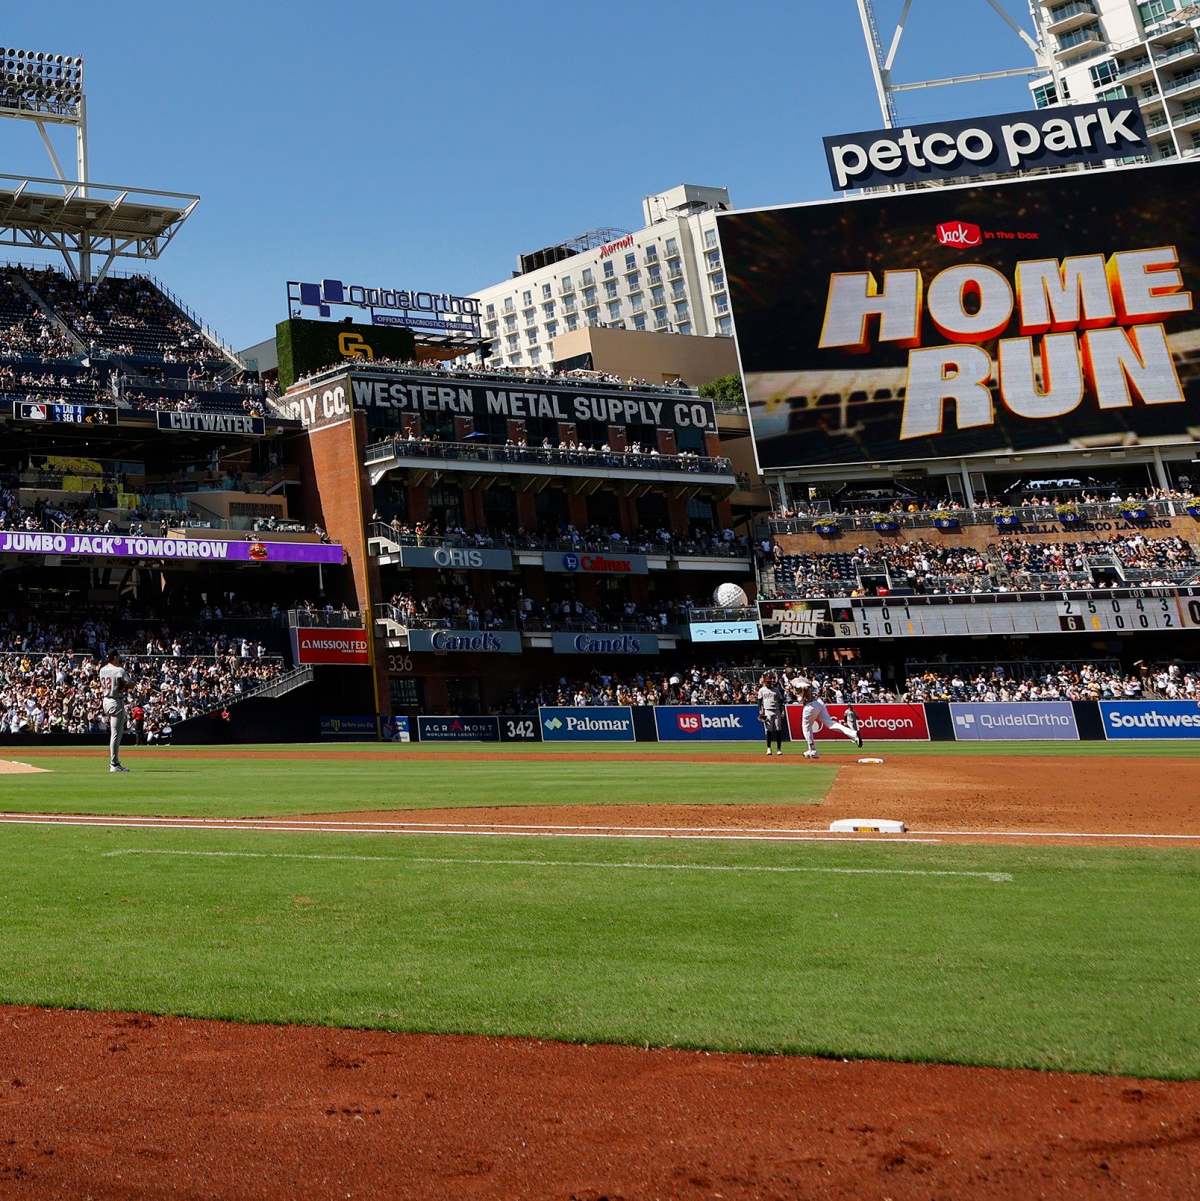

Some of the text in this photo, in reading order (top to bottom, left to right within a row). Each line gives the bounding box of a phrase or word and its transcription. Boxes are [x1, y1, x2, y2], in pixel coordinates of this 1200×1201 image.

[831, 107, 1142, 187] petco park
[939, 223, 1039, 244] Jack in the box
[349, 285, 475, 315] QuidelOrtho
[817, 245, 1193, 350] HOME
[377, 316, 473, 330] OFFICIAL DIAGNOSTICS PARTNER
[899, 322, 1187, 441] RUN
[62, 405, 74, 414] LAD
[323, 386, 350, 419] CO.
[351, 380, 715, 428] WESTERN METAL SUPPLY CO.
[62, 414, 74, 423] SEA
[170, 412, 254, 434] CUTWATER
[2, 533, 67, 553] JUMBO
[125, 538, 228, 558] TOMORROW
[434, 548, 483, 568] ORIS
[581, 556, 632, 572] Calimax
[1062, 592, 1069, 601] R
[1086, 591, 1093, 600] H
[1110, 590, 1116, 599] E
[1129, 589, 1145, 598] LOB
[1151, 588, 1171, 597] MVR
[1187, 587, 1194, 596] B
[771, 609, 826, 622] HOME
[860, 607, 867, 620] 1
[882, 607, 890, 620] 0
[904, 606, 910, 619] 1
[1063, 601, 1073, 615] 2
[1087, 600, 1097, 614] 5
[1111, 599, 1120, 613] 0
[1136, 598, 1144, 612] 4
[1159, 598, 1169, 611] 3
[780, 622, 818, 636] RUN
[862, 623, 870, 636] 5
[884, 622, 892, 635] 0
[1067, 616, 1077, 630] 6
[1115, 615, 1124, 628] 0
[1139, 614, 1148, 628] 0
[1163, 613, 1173, 627] 2
[312, 640, 368, 650] MISSION FED
[431, 631, 502, 651] Canel's
[573, 634, 641, 654] Canel's
[388, 654, 413, 671] 336
[425, 719, 493, 732] AGRAMONT
[565, 716, 629, 731] Palomar
[679, 714, 742, 729] us bank
[980, 713, 1070, 729] QuidelOrtho
[1109, 710, 1200, 728] Southwes
[506, 720, 535, 738] 342
